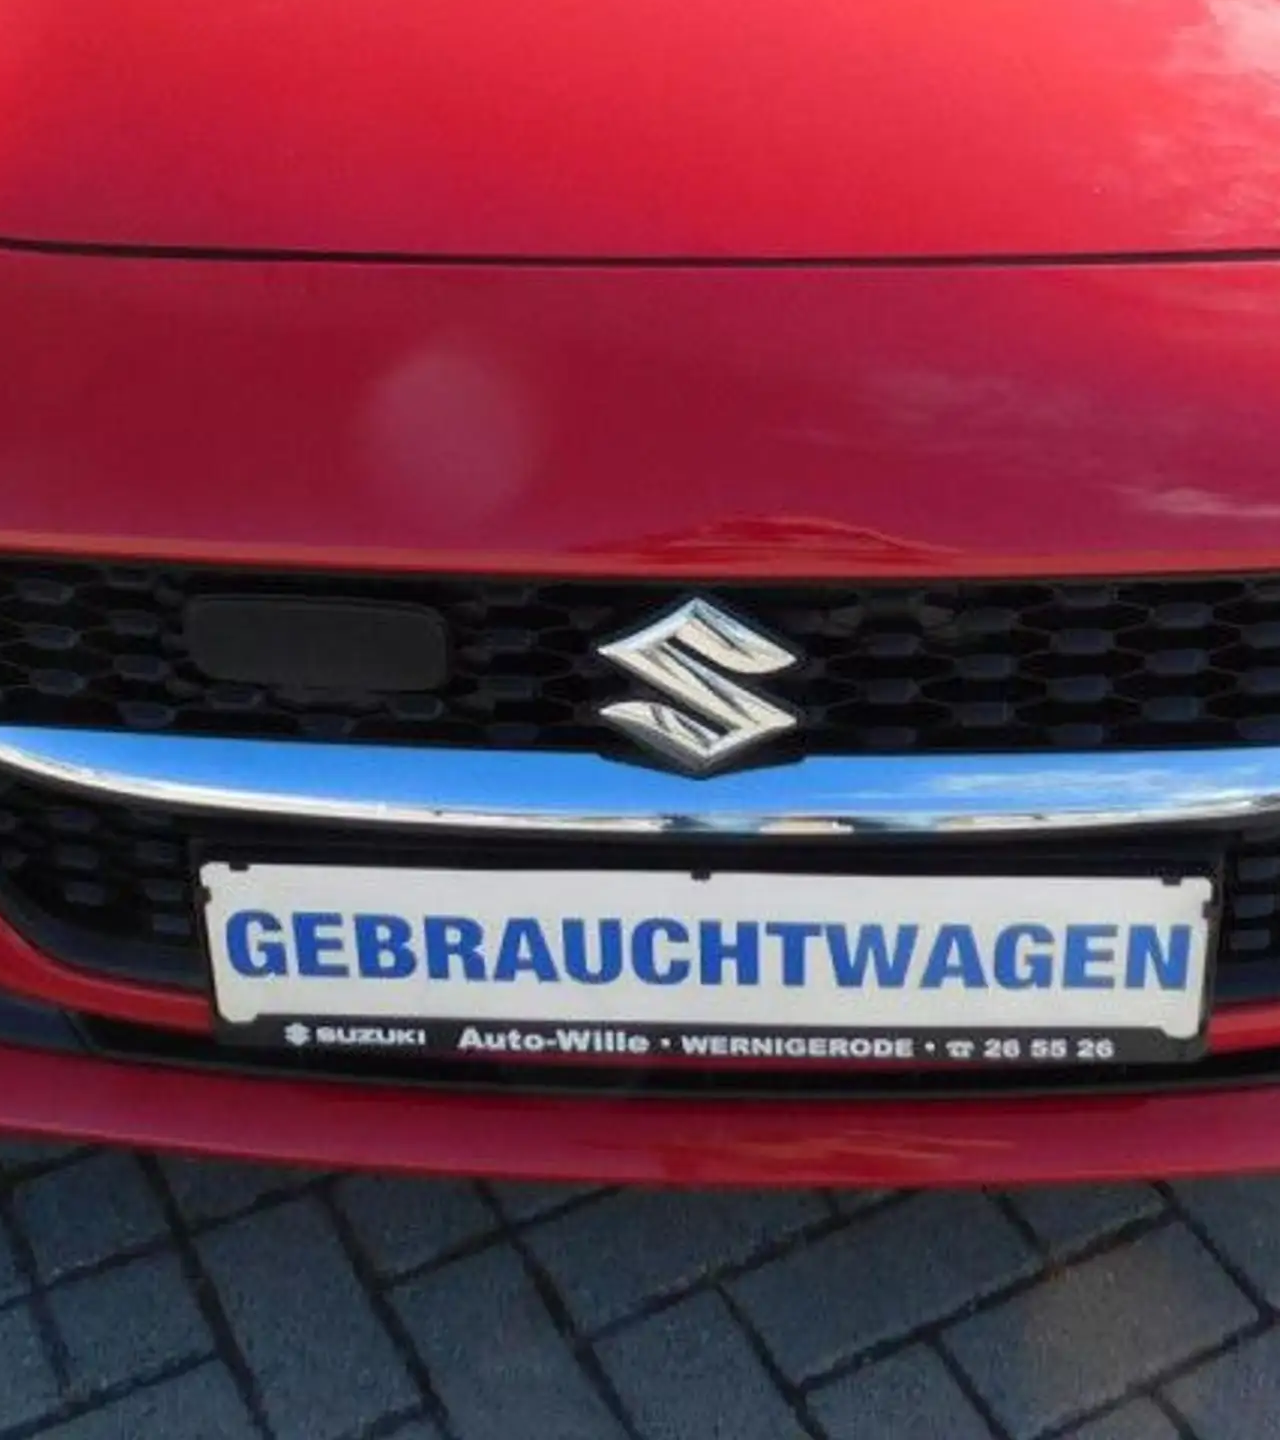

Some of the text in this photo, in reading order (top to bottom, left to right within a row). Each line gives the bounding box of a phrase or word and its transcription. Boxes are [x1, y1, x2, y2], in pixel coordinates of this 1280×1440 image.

[225, 908, 1192, 991] GEBRAUCHTWAGEN
[316, 1026, 1115, 1060] SUZUKI Auto-Wille WERNIGERODE 26 55 26
